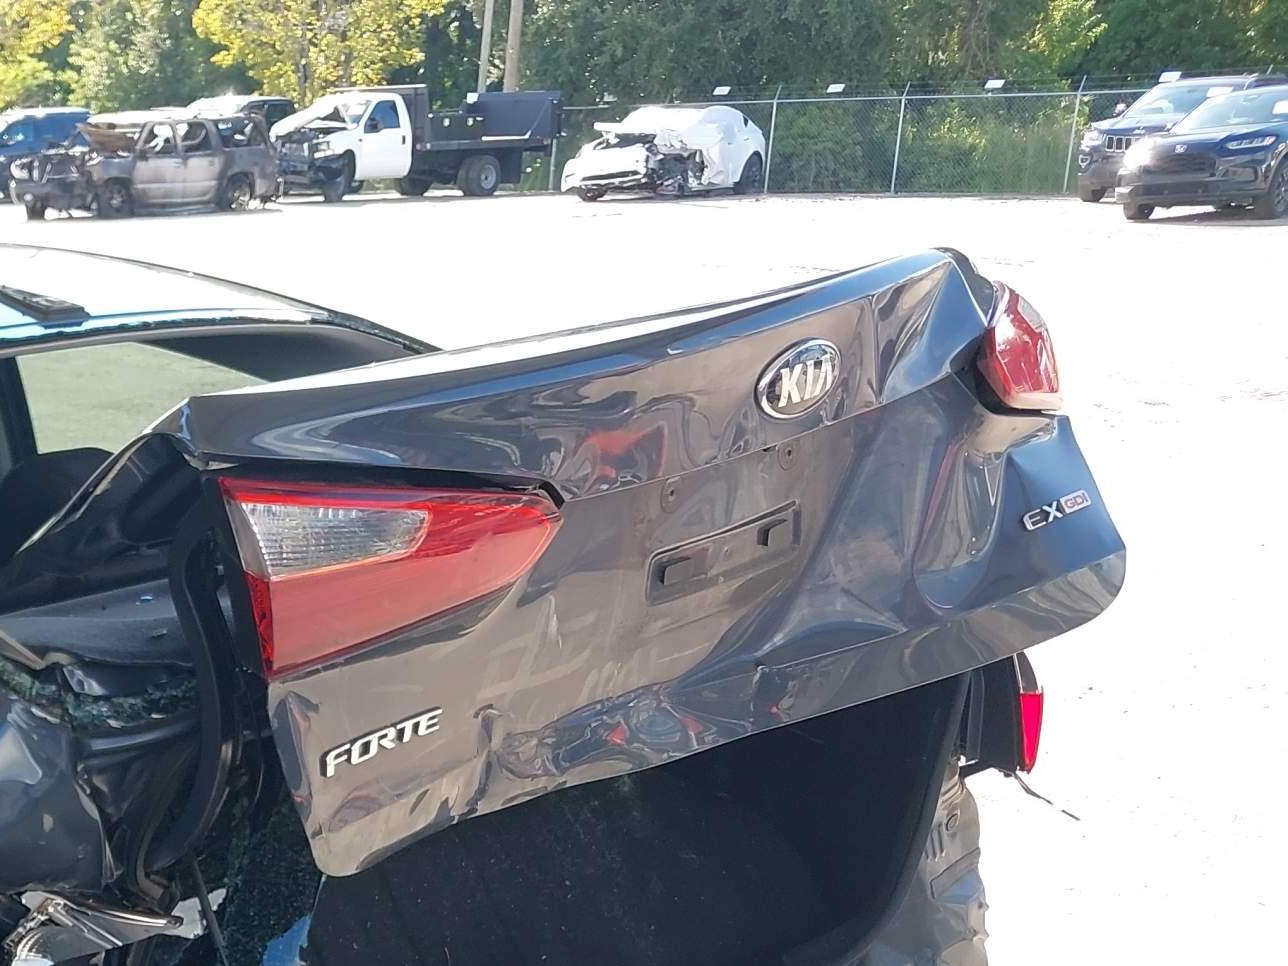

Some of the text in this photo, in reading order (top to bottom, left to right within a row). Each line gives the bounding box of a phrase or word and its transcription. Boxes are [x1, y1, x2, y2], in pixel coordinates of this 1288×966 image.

[778, 354, 834, 408] KIA
[1023, 501, 1063, 530] EX
[323, 707, 443, 777] FORTE
